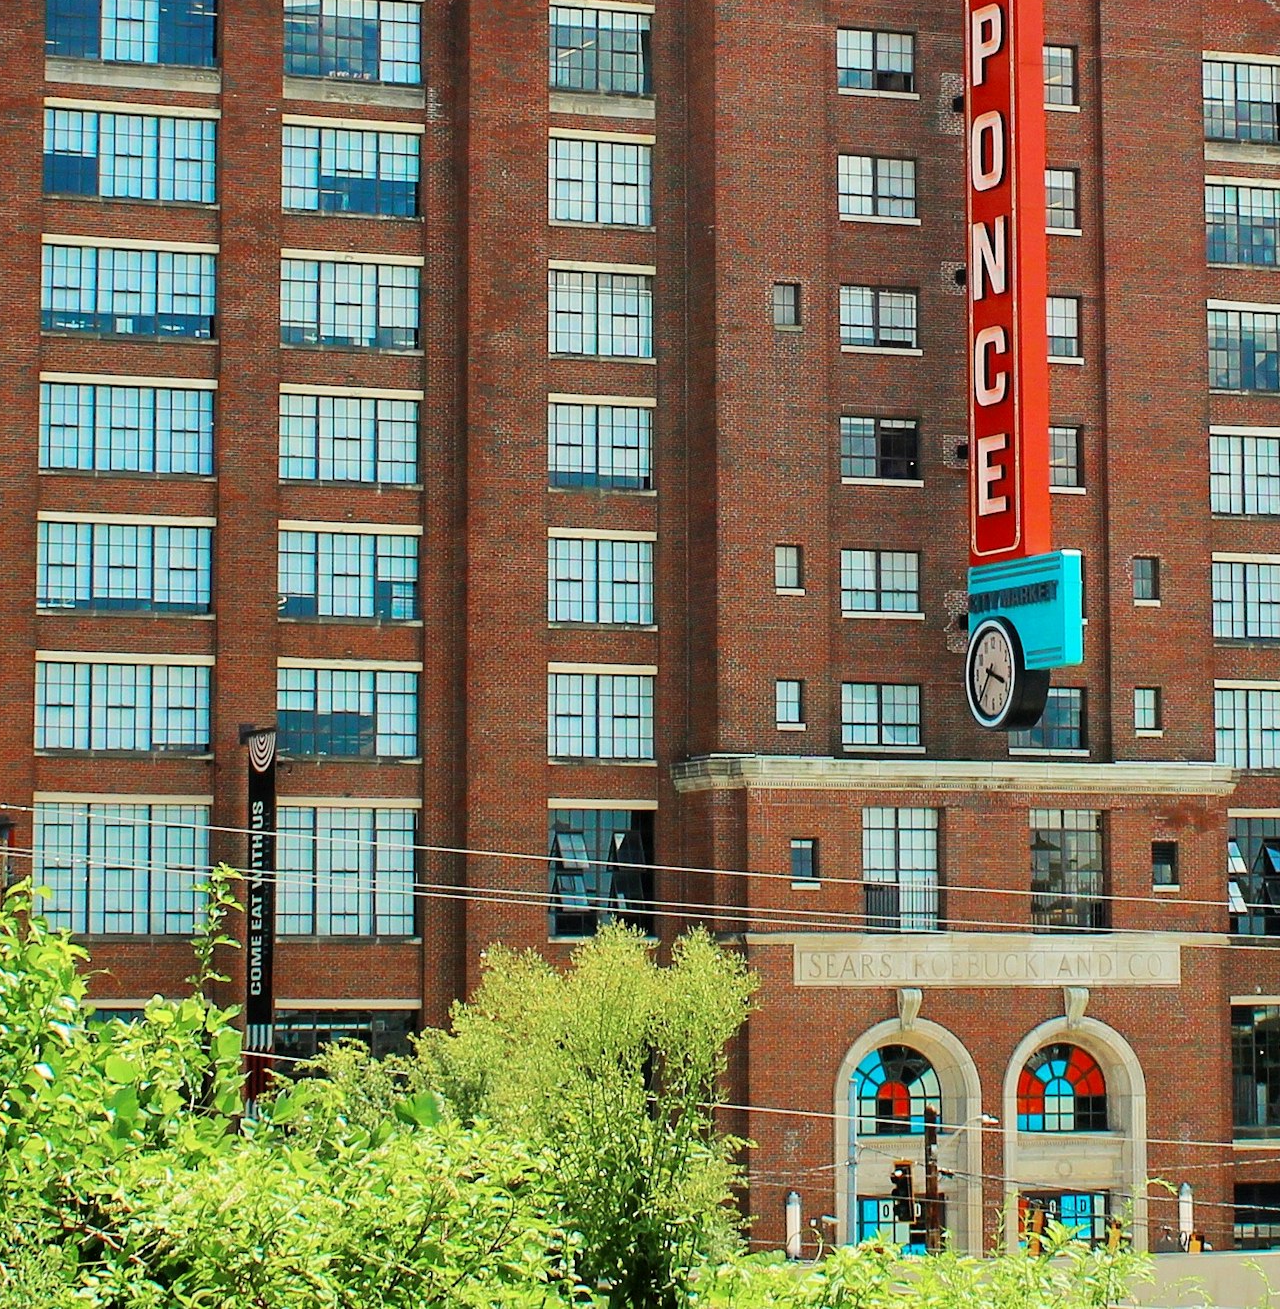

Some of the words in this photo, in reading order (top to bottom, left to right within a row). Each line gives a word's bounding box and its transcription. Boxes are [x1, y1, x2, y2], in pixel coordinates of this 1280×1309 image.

[971, 2, 1008, 518] PONCE
[968, 590, 1001, 613] CITY
[1001, 579, 1059, 608] MARKET
[252, 800, 264, 830] US
[251, 835, 263, 890] WITH
[251, 894, 263, 931] EAT
[250, 936, 262, 996] COME
[914, 953, 1038, 979] ROEBUCK
[1056, 953, 1113, 978] AND
